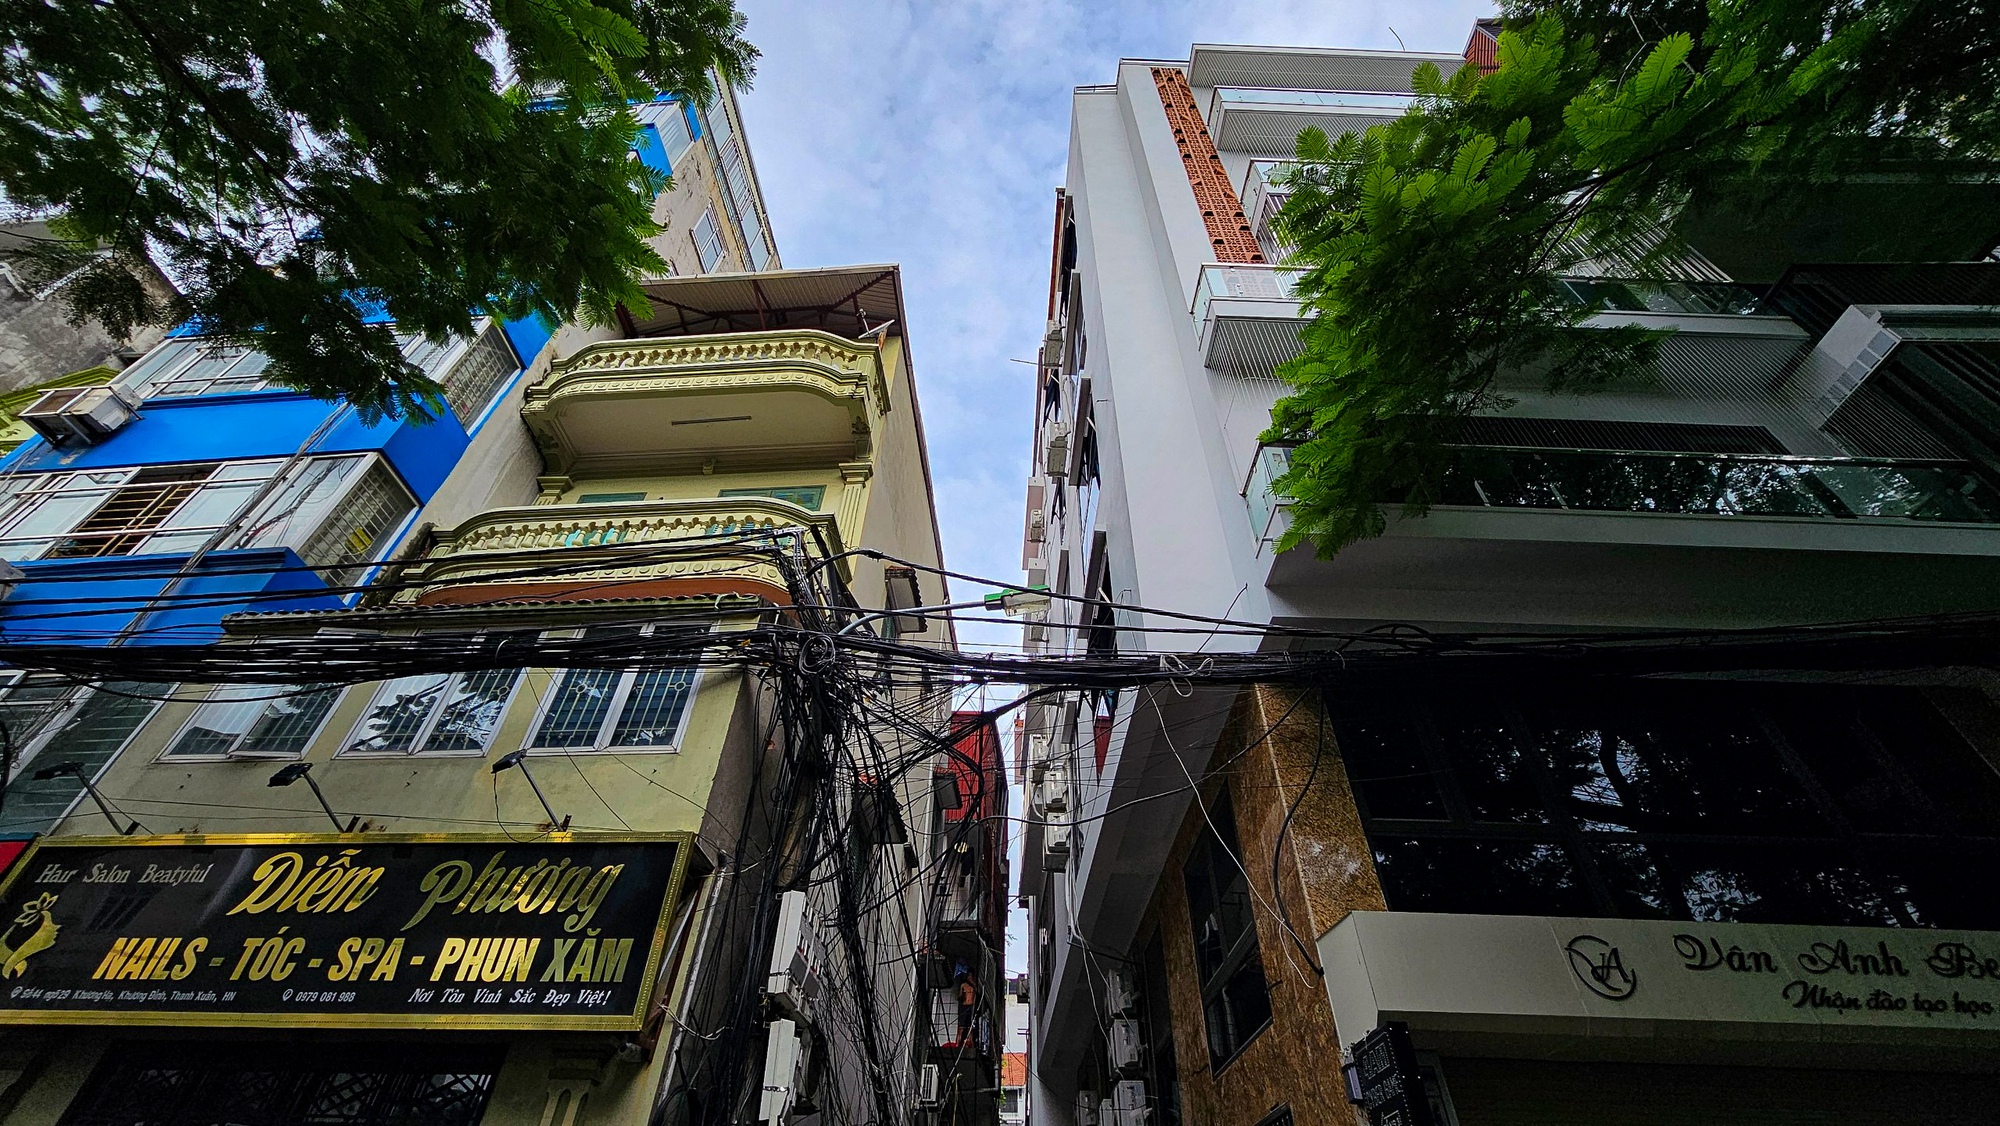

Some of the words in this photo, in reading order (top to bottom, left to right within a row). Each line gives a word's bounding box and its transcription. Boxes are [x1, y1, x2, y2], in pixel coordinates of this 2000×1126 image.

[35, 864, 77, 883] Hair
[82, 863, 131, 883] Salon
[138, 863, 215, 887] Beatyful
[226, 847, 386, 915] Diễm
[400, 851, 626, 932] Phương
[92, 937, 208, 980] NAILS
[229, 926, 306, 981] TÓC
[327, 937, 405, 982] SPA
[429, 937, 541, 982] PHUN
[540, 927, 634, 983] XĂM
[1673, 934, 1778, 973] Vân
[1798, 939, 1910, 976] Anh
[295, 991, 319, 1003] 0979
[319, 991, 338, 1003] 081
[337, 991, 357, 1003] 988
[440, 989, 466, 1003] Tôn
[472, 989, 503, 1004] Vinh
[1782, 980, 1862, 1015] Nhận
